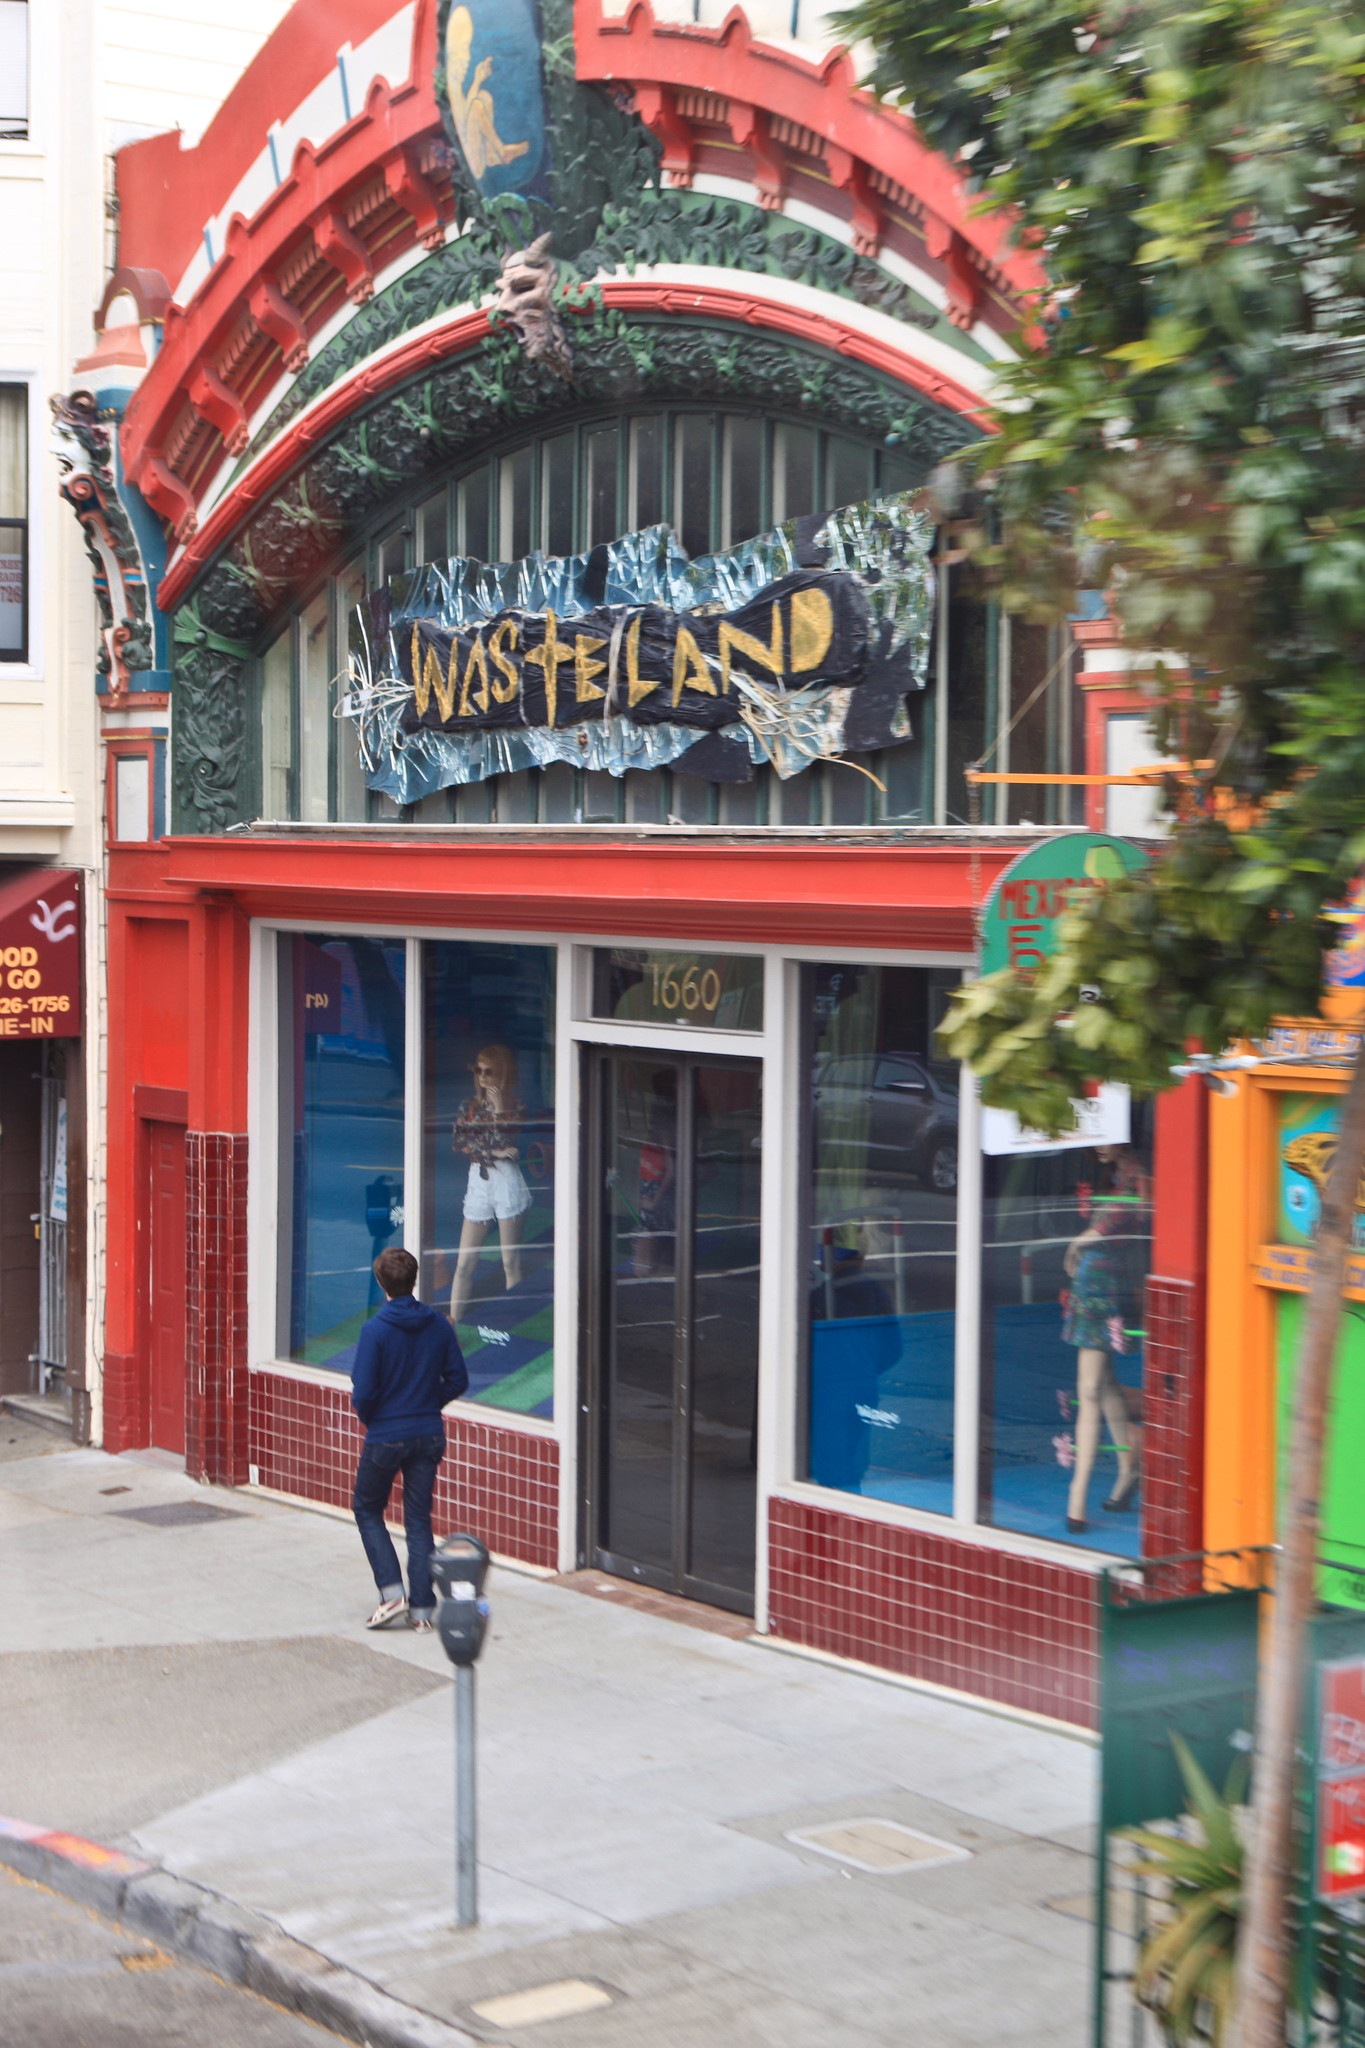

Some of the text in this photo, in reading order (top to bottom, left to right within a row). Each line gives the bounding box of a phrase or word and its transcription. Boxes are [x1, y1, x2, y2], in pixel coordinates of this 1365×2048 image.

[409, 586, 834, 730] WASTELAND
[0, 946, 38, 967] OD
[7, 968, 41, 989] GO
[651, 962, 721, 1012] 1660
[0, 1016, 54, 1035] E-IN
